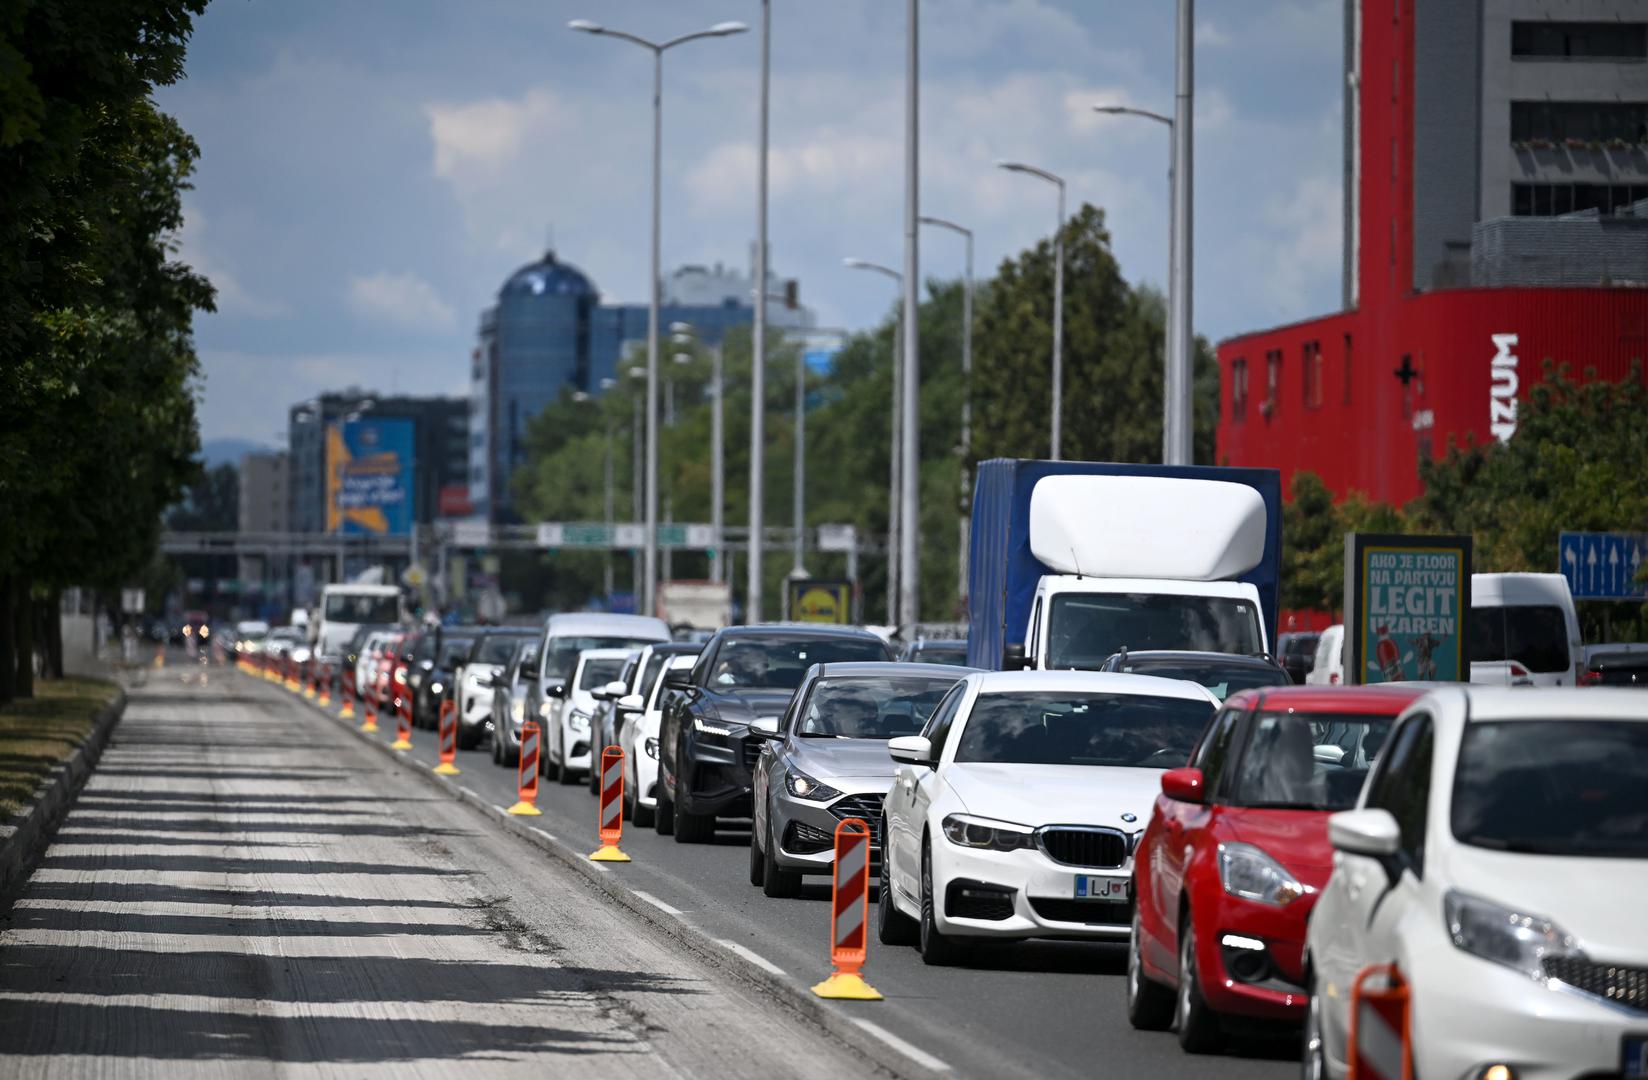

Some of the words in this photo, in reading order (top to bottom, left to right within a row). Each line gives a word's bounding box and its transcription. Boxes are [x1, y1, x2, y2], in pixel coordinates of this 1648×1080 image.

[1370, 554, 1396, 569] AKO
[1399, 554, 1413, 569] JE
[1416, 555, 1455, 569] FLOOR
[1370, 569, 1391, 585] NA
[1394, 570, 1455, 586] PARTYJU
[1370, 586, 1455, 615] LEGIT
[1091, 879, 1111, 897] LJ
